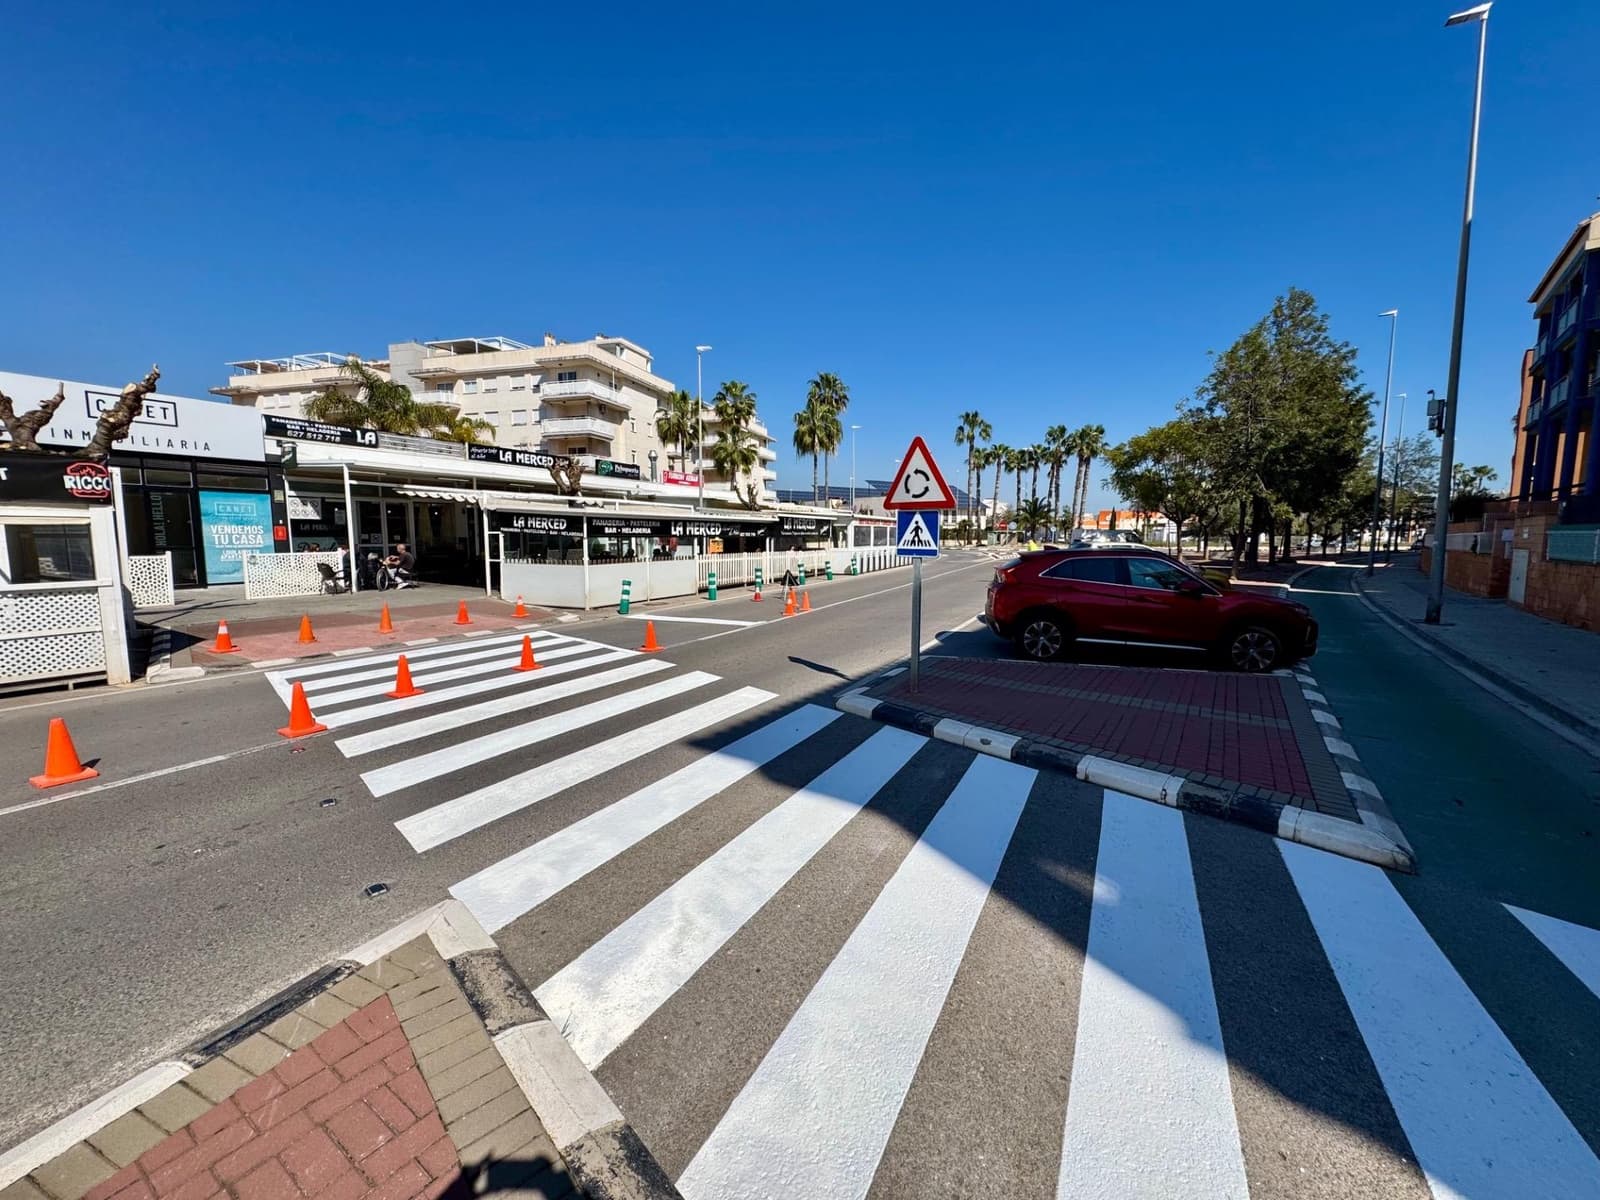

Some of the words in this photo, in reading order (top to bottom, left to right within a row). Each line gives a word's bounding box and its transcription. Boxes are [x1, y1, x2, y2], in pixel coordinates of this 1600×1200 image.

[96, 399, 169, 420] CET
[51, 427, 211, 451] INMILIARIA
[355, 429, 377, 445] LA
[499, 450, 512, 463] LA
[515, 452, 554, 467] MERCED
[219, 504, 253, 514] CANET
[210, 524, 264, 535] VENDEMOS
[513, 515, 525, 528] LA
[527, 517, 567, 531] MERCED
[592, 519, 626, 527] PANADERIA
[629, 520, 661, 528] PASTELERIA
[604, 526, 616, 534] BAR
[620, 527, 652, 535] HELADERIA
[670, 521, 684, 537] LA
[686, 521, 723, 537] MERCED
[783, 517, 793, 531] LA
[794, 518, 818, 532] MERCED
[213, 534, 229, 545] TU
[232, 534, 265, 545] CASA
